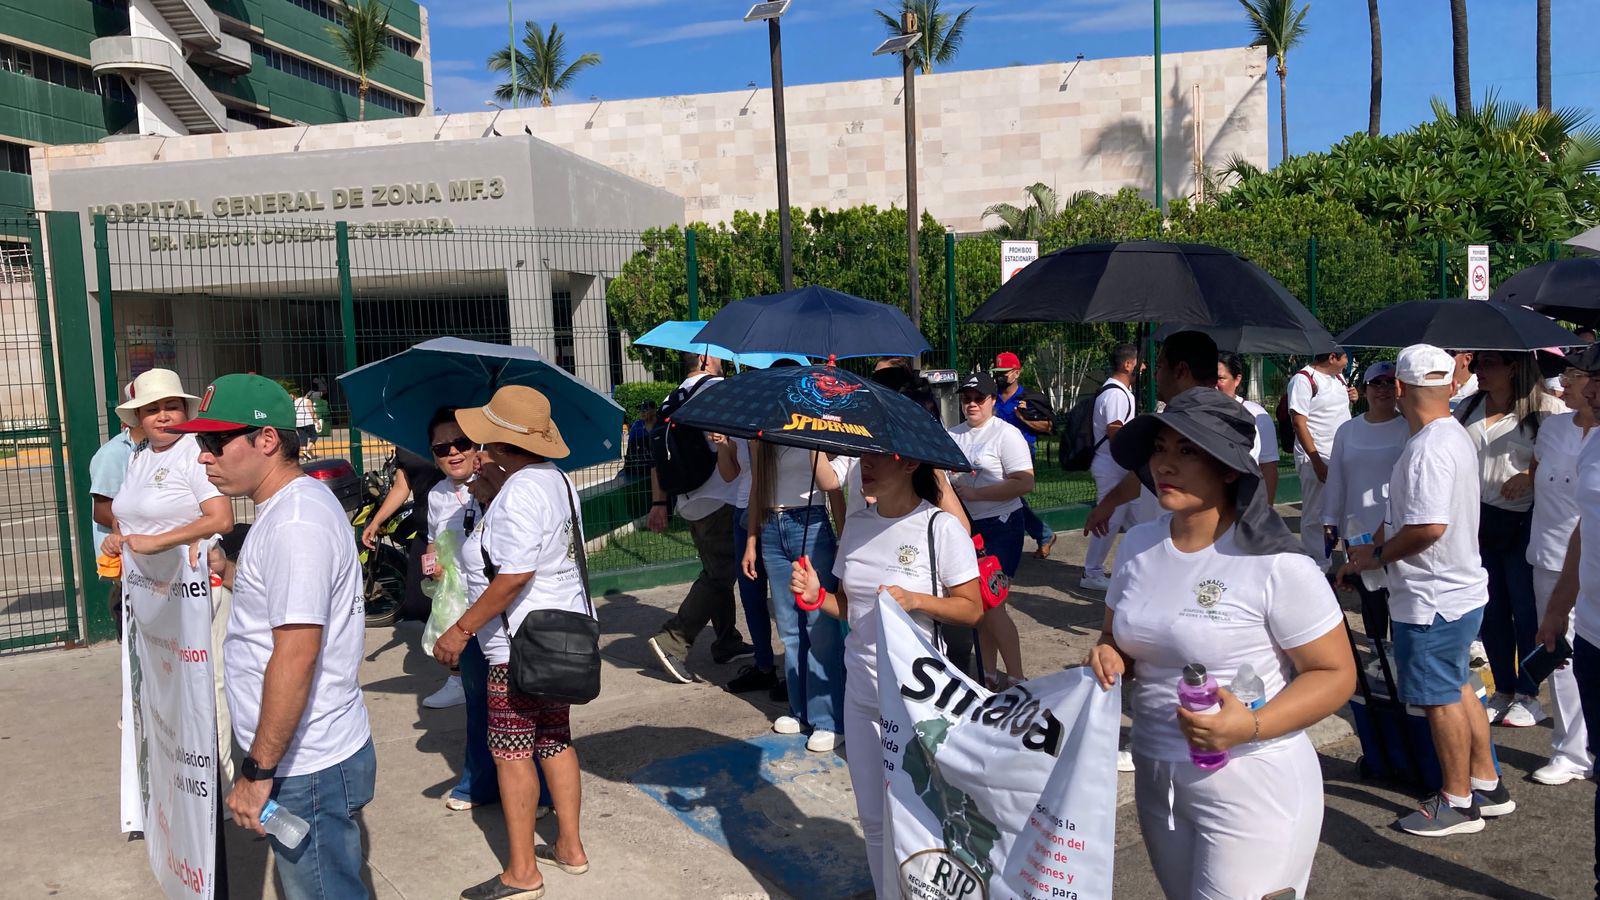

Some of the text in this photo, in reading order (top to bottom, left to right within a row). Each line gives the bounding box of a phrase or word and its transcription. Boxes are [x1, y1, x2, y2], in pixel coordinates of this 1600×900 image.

[88, 199, 204, 226] HOSPITAL
[211, 189, 325, 218] GENERAL
[332, 187, 364, 210] DE
[371, 181, 442, 207] ZONA
[149, 233, 178, 251] DR.
[261, 221, 358, 244] GONZALZ
[363, 216, 454, 238] GUEVARA
[1198, 580, 1228, 593] SINALOA
[185, 777, 208, 798] IMSS
[1065, 819, 1076, 831] la
[1067, 838, 1085, 851] del
[1054, 851, 1067, 863] de
[1067, 874, 1074, 884] y
